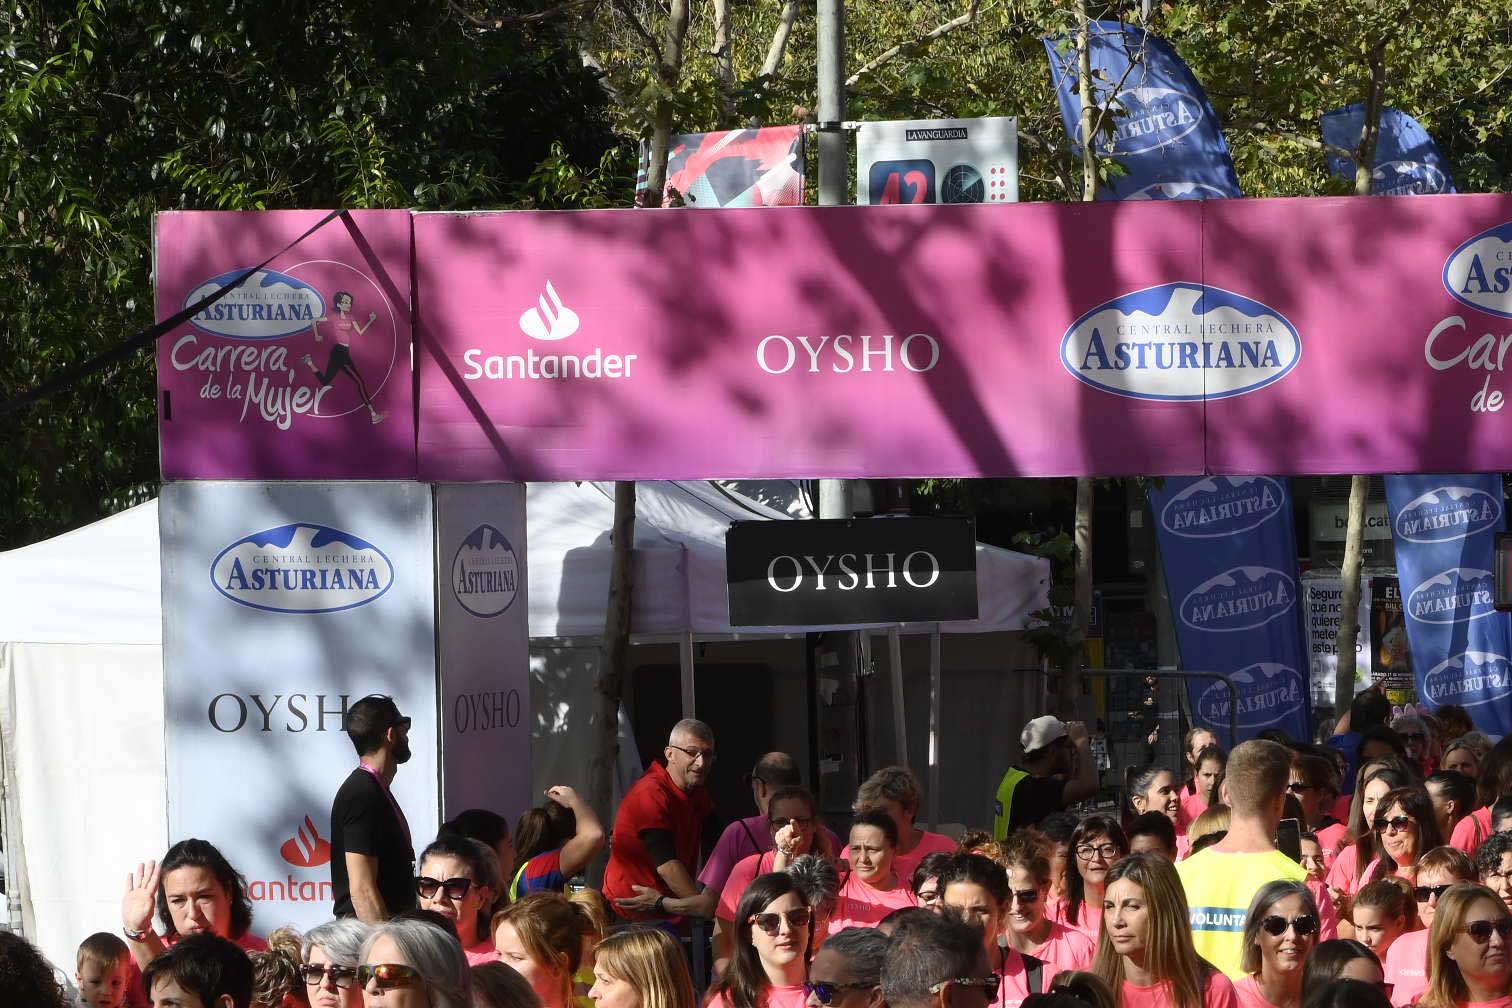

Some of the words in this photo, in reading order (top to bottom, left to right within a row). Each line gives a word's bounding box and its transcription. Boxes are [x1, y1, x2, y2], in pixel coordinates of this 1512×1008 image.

[918, 129, 967, 139] VANGUARDIA
[194, 295, 314, 321] ASTURIANA
[1116, 323, 1192, 335] CENTRAL
[1199, 322, 1275, 335] LECHERA
[170, 335, 288, 372] Carrera
[463, 348, 637, 380] Santander
[756, 333, 940, 374] OYSHO
[1080, 330, 1282, 371] ASTURIANA
[200, 374, 221, 399] de
[226, 372, 242, 400] la
[240, 368, 333, 431] Mujer
[1470, 375, 1504, 412] de
[225, 557, 380, 591] ASTURIANA
[253, 555, 311, 563] CENTRAL
[316, 554, 375, 563] LECHERA
[767, 551, 940, 592] OYSHO
[457, 562, 516, 596] ASTURIANA
[1312, 643, 1331, 653] este
[455, 689, 520, 734] OYSHO
